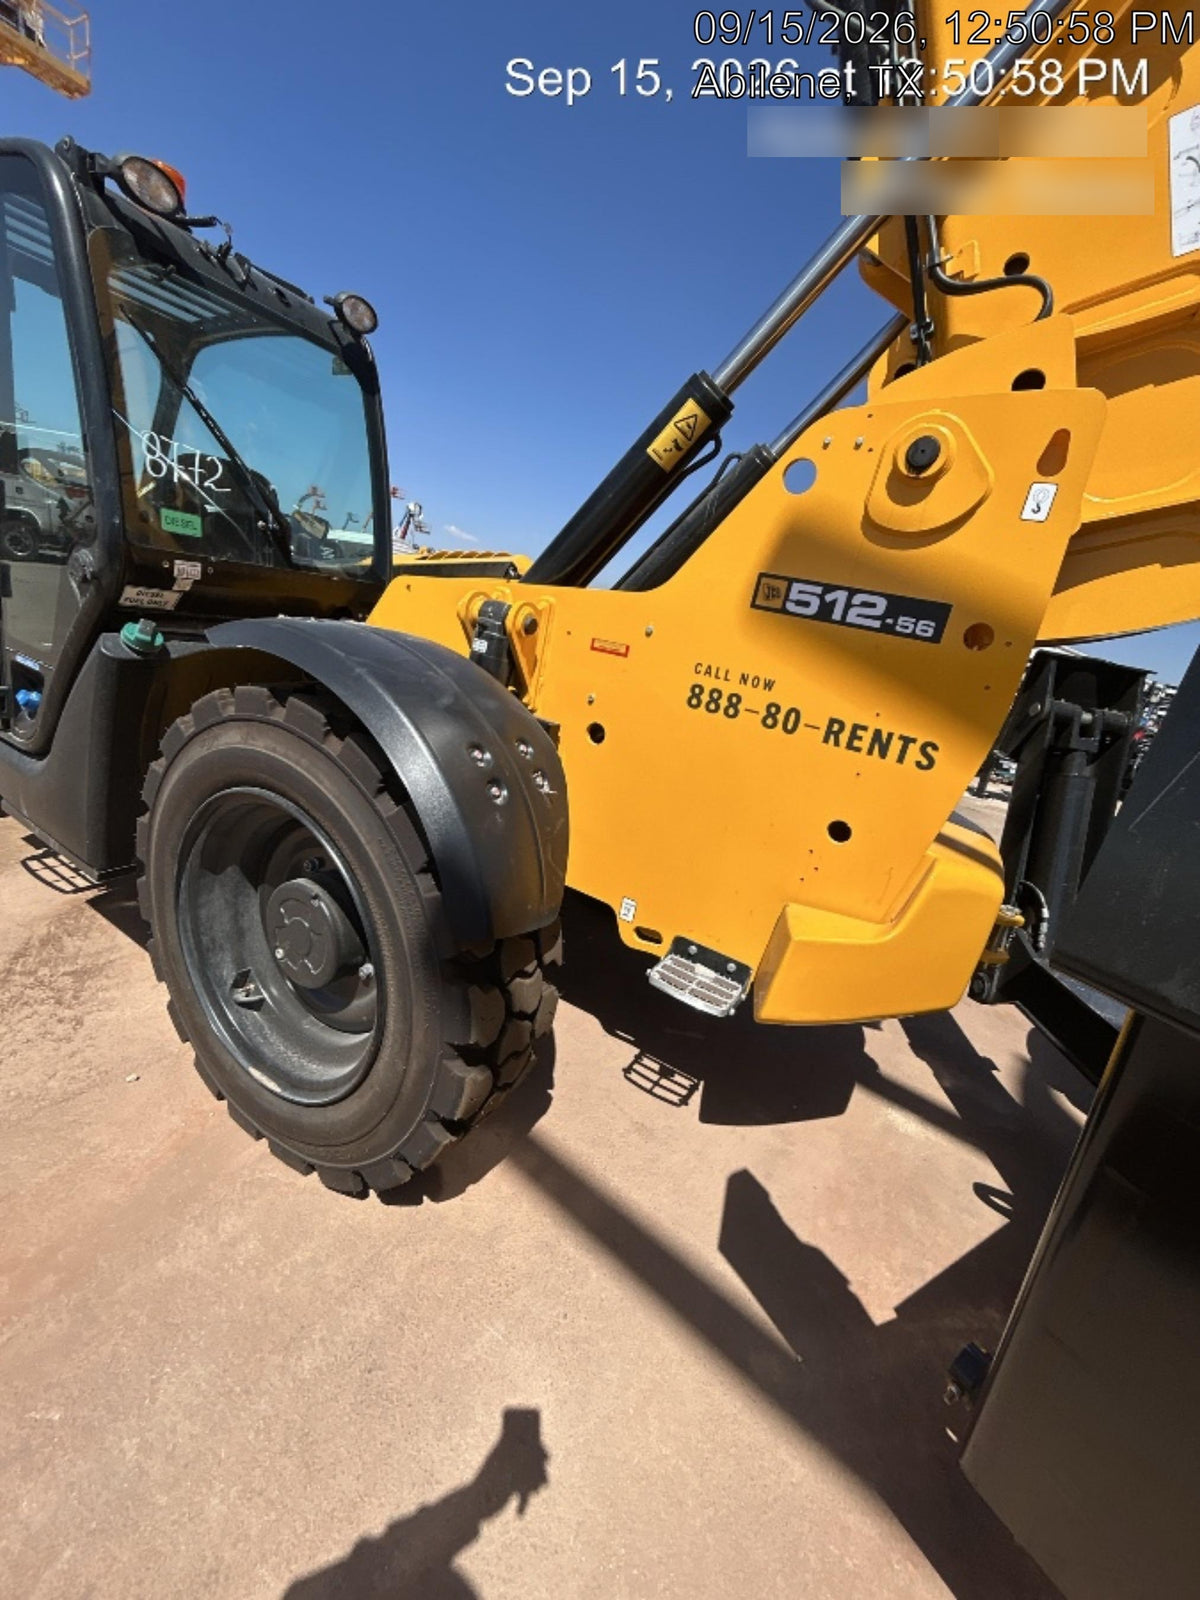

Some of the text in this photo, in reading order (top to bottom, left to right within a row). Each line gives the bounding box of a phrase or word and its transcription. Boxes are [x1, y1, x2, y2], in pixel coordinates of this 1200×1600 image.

[164, 515, 198, 531] DIESEL
[694, 662, 776, 692] CALL NOW
[687, 683, 940, 771] 888-80-RENTS
